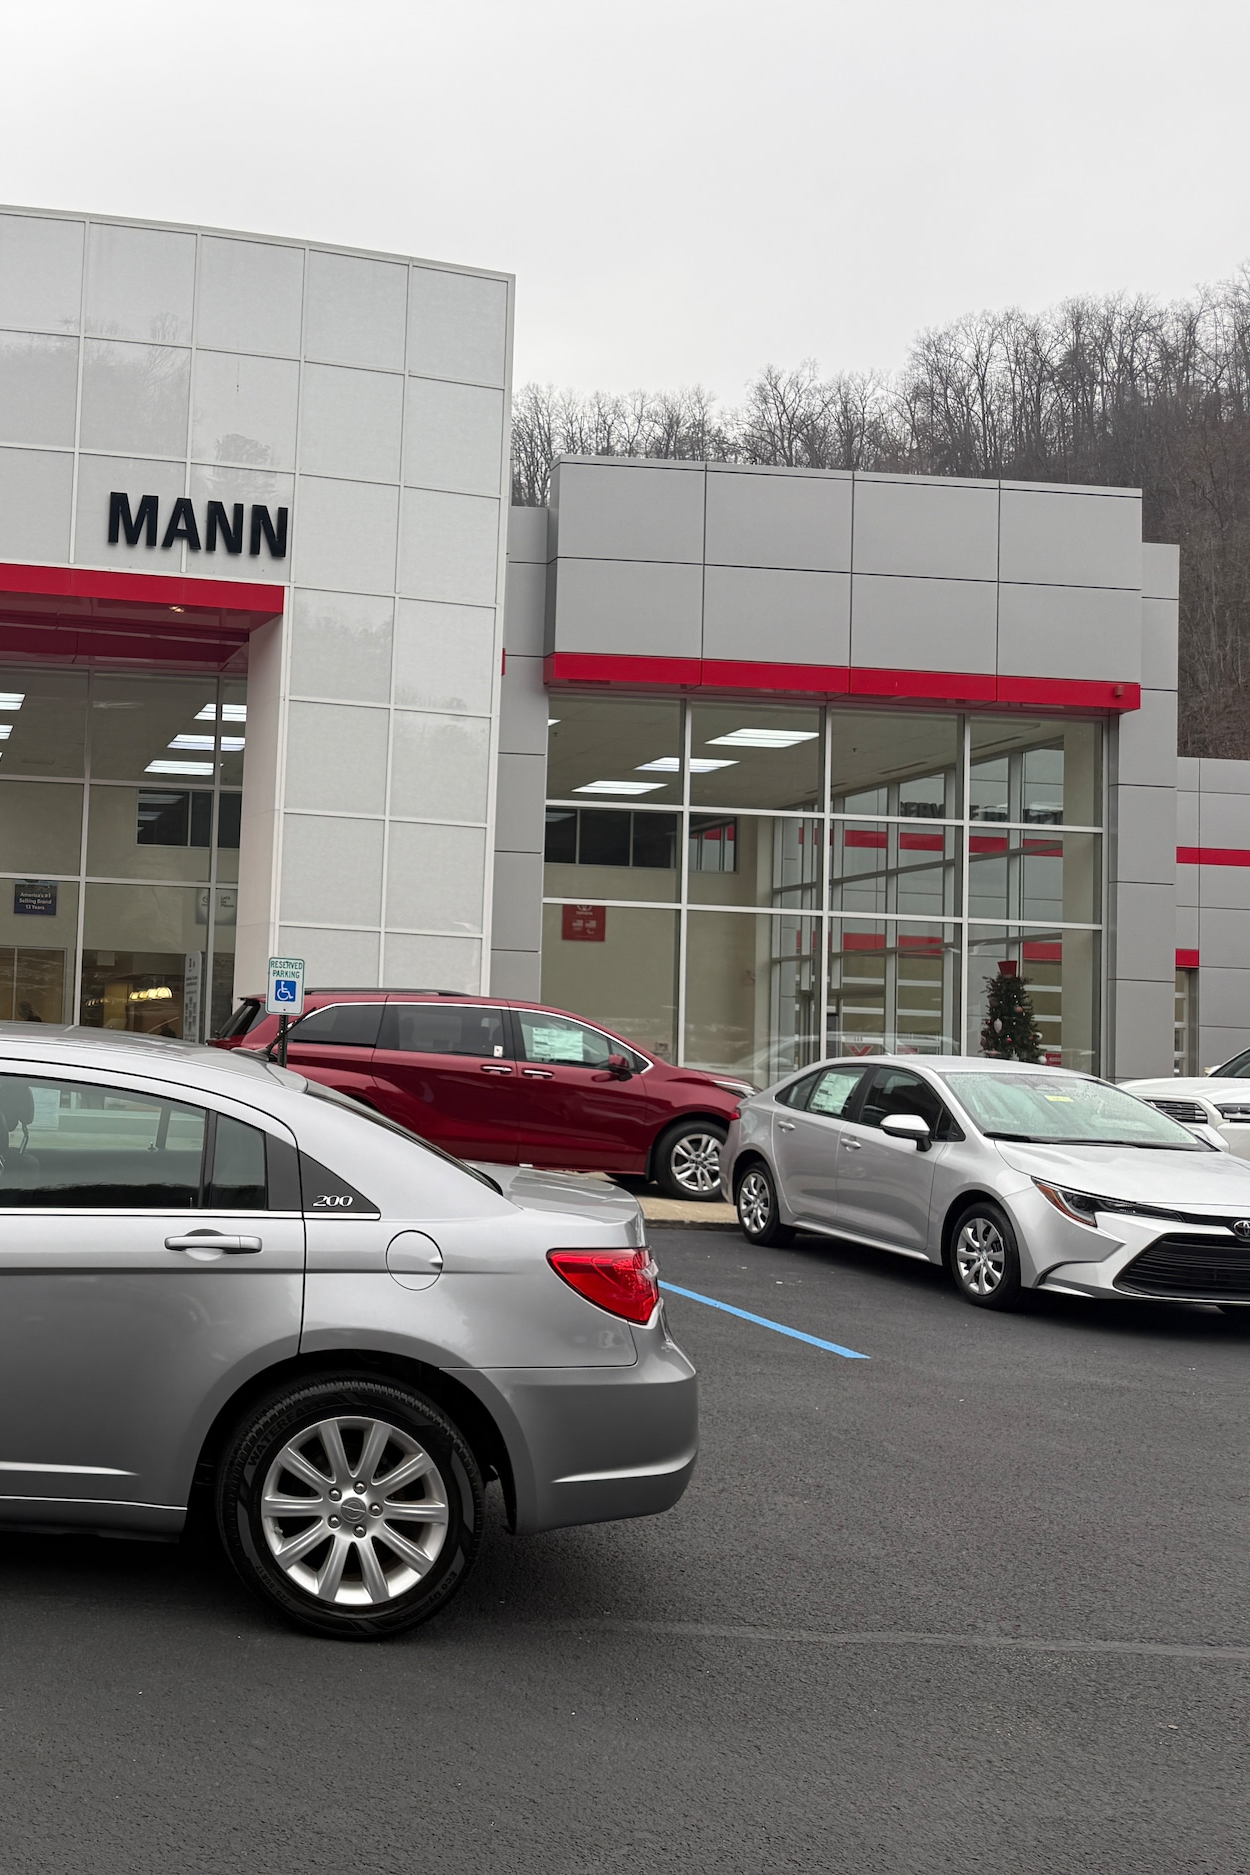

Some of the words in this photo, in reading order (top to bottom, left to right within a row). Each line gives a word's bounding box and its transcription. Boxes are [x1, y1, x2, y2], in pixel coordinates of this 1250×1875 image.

[108, 491, 289, 558] MANN
[270, 961, 303, 970] RESERVED
[272, 970, 300, 979] PARKING
[312, 1195, 353, 1207] 200
[441, 1570, 457, 1590] Eco
